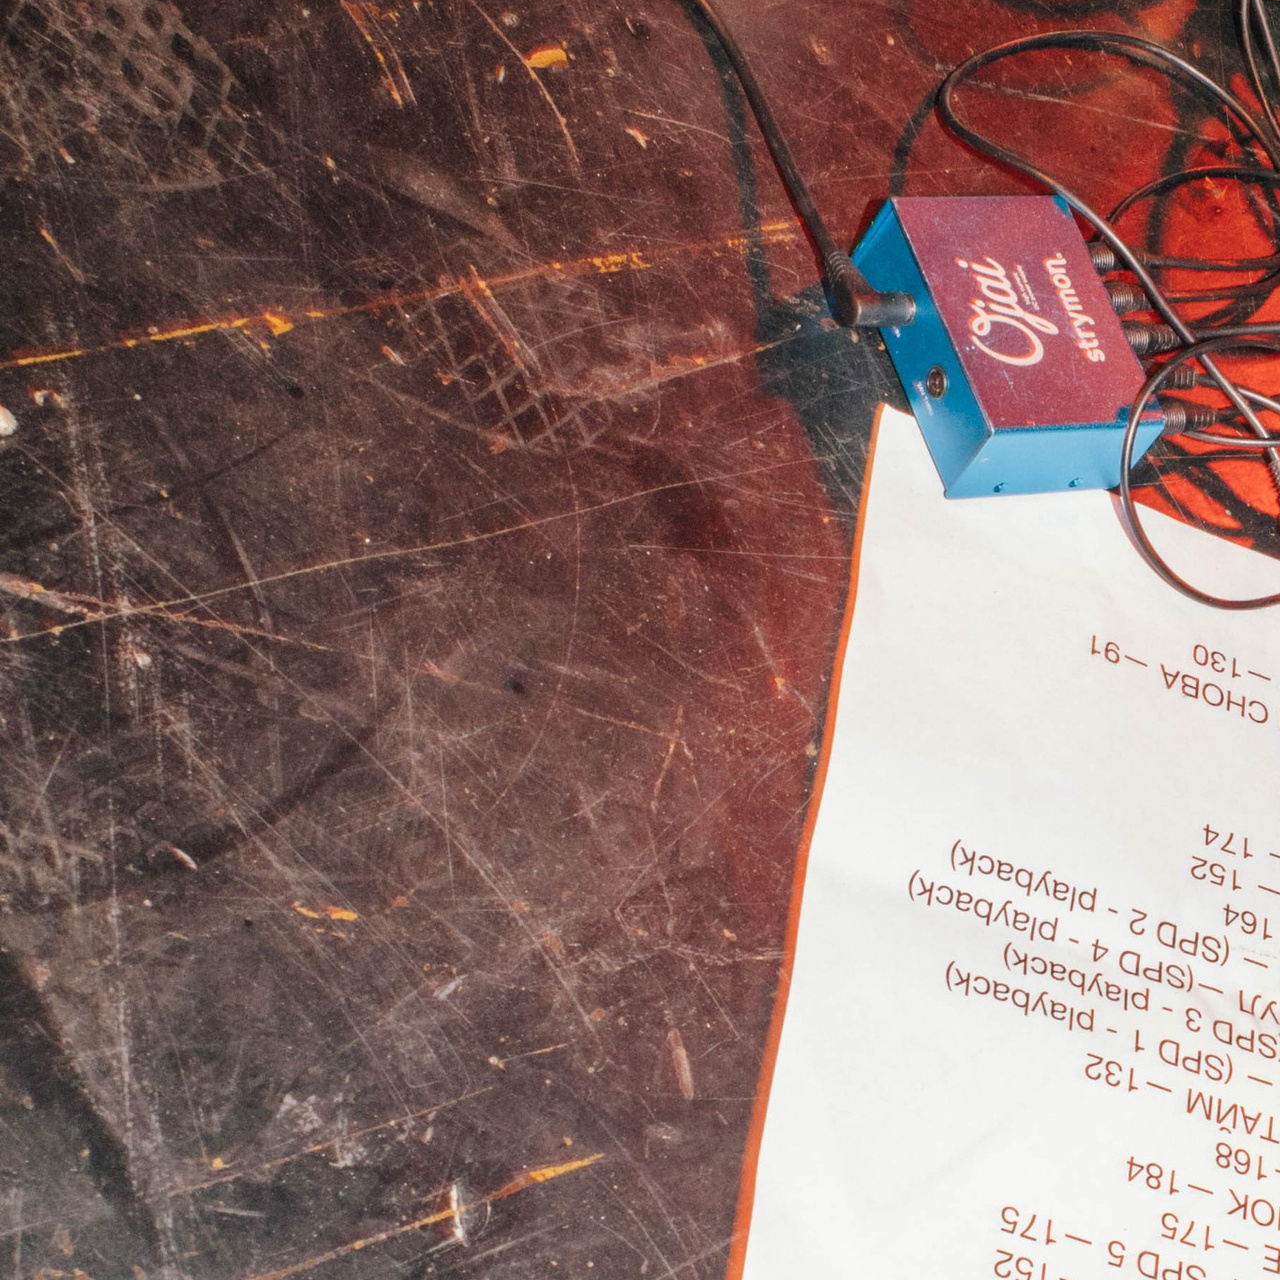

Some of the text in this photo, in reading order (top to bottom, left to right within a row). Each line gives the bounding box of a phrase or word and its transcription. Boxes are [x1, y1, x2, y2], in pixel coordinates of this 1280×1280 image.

[958, 257, 1059, 365] Ojai
[1160, 664, 1268, 723] СНОВА
[1203, 824, 1253, 859] 174
[951, 839, 1097, 912] playback)
[1191, 856, 1242, 891] 152
[909, 870, 1058, 942] playback)
[1130, 909, 1147, 935] 2
[1223, 904, 1272, 940] 164
[1092, 939, 1108, 962] 4
[1157, 921, 1229, 966] (SPD
[946, 961, 1094, 1032] playback)
[1004, 942, 1149, 1011] playback)
[1186, 1008, 1202, 1032] 3
[1135, 1030, 1144, 1052] 1
[1159, 1039, 1233, 1084] (SPD
[1108, 1241, 1125, 1268] 5
